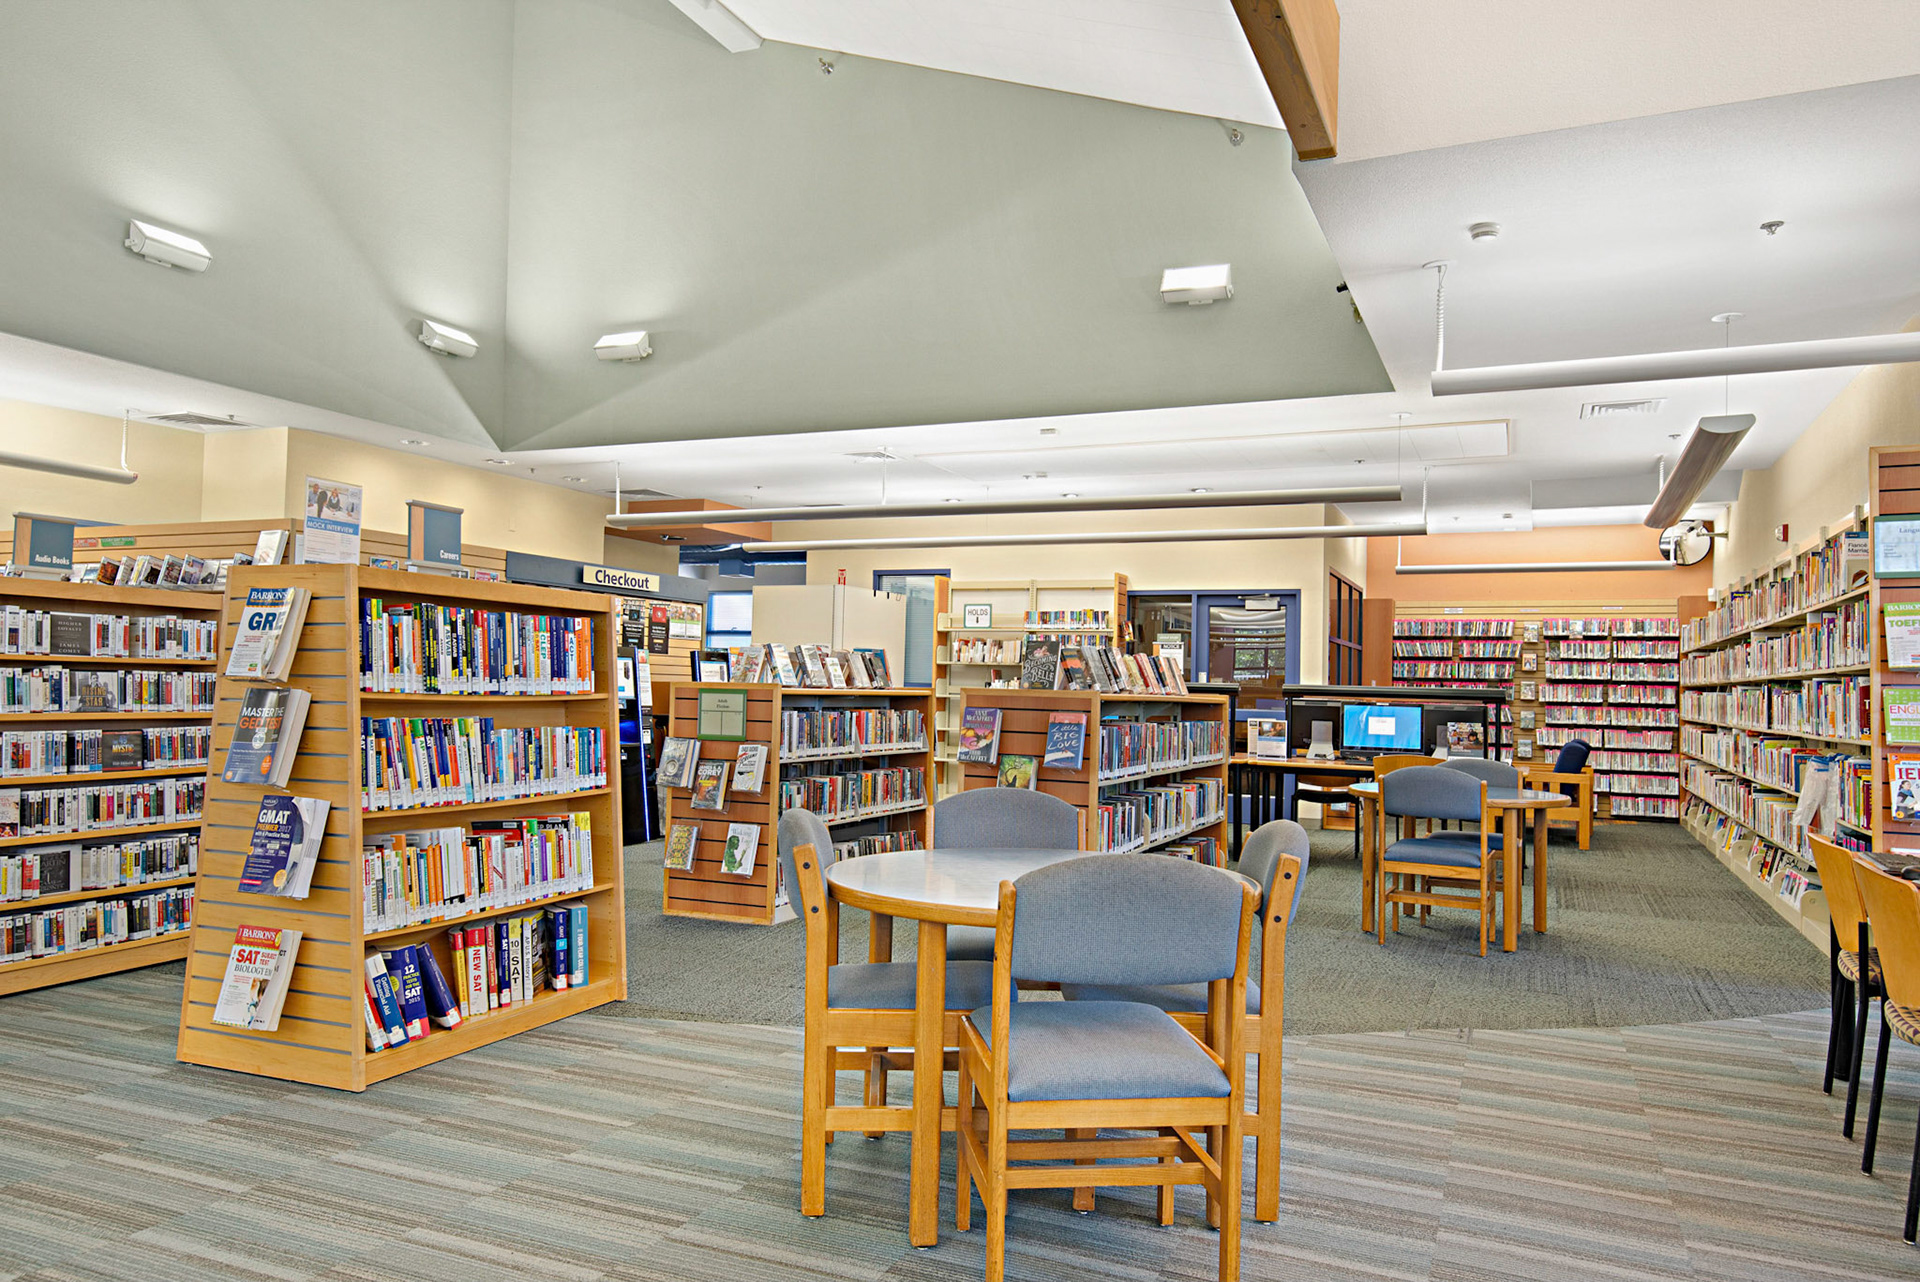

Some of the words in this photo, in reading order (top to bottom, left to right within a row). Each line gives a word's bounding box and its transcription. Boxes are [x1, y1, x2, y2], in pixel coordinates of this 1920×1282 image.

[307, 521, 326, 530] MOCK
[326, 524, 354, 534] INTERVIEW
[35, 554, 52, 564] Audio
[52, 555, 70, 566] Books
[439, 550, 460, 561] Careers
[594, 569, 650, 589] Checkout
[250, 590, 288, 601] BARRON'S
[248, 612, 286, 631] GRE
[1024, 654, 1058, 674] BECOMING
[1030, 666, 1054, 682] BELLE
[82, 686, 107, 695] RISING
[85, 697, 104, 706] STAR
[242, 707, 275, 717] MASTER
[274, 706, 285, 716] THE
[240, 716, 263, 729] GED
[264, 717, 282, 729] TEST
[1053, 732, 1079, 742] BIG
[420, 740, 425, 751] AP
[1047, 740, 1080, 750] LOVE
[258, 809, 291, 824] GMAT
[256, 824, 278, 832] PREMIER
[242, 928, 276, 940] BARRON'S
[236, 948, 260, 965] SAT
[472, 949, 481, 971] NEW
[234, 964, 264, 975] BIOLOGY
[404, 964, 414, 974] 12
[403, 972, 420, 980] PRACTICE
[380, 976, 391, 998] Getting
[473, 974, 482, 992] SAT
[375, 979, 388, 1005] Financial
[383, 1004, 391, 1016] Aid
[405, 986, 421, 999] SAT
